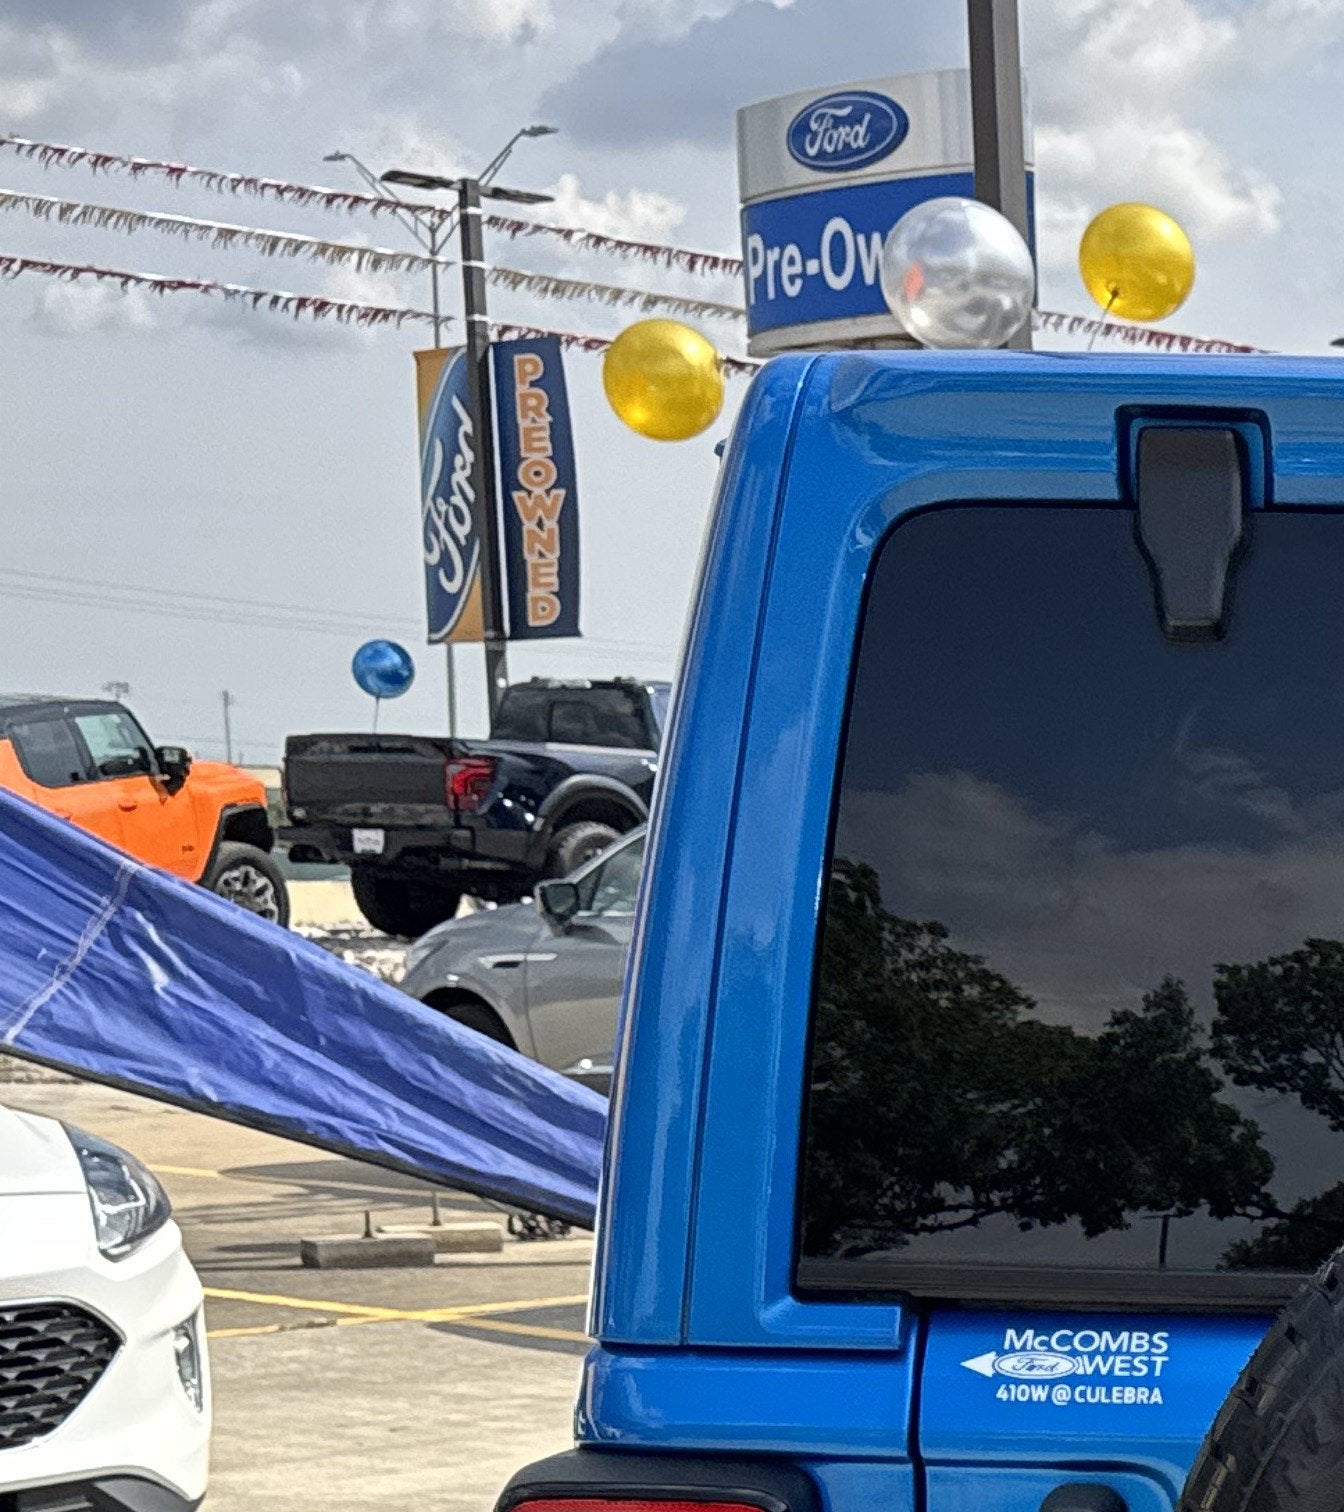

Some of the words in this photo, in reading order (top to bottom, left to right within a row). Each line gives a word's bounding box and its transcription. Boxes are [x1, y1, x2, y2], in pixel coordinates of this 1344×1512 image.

[804, 105, 871, 157] Ford
[746, 215, 886, 305] Pre-Ow
[512, 352, 566, 627] PREOWNED
[1003, 1328, 1170, 1354] McCOMBS
[1012, 1357, 1060, 1373] Ford
[1083, 1355, 1170, 1377] WEST
